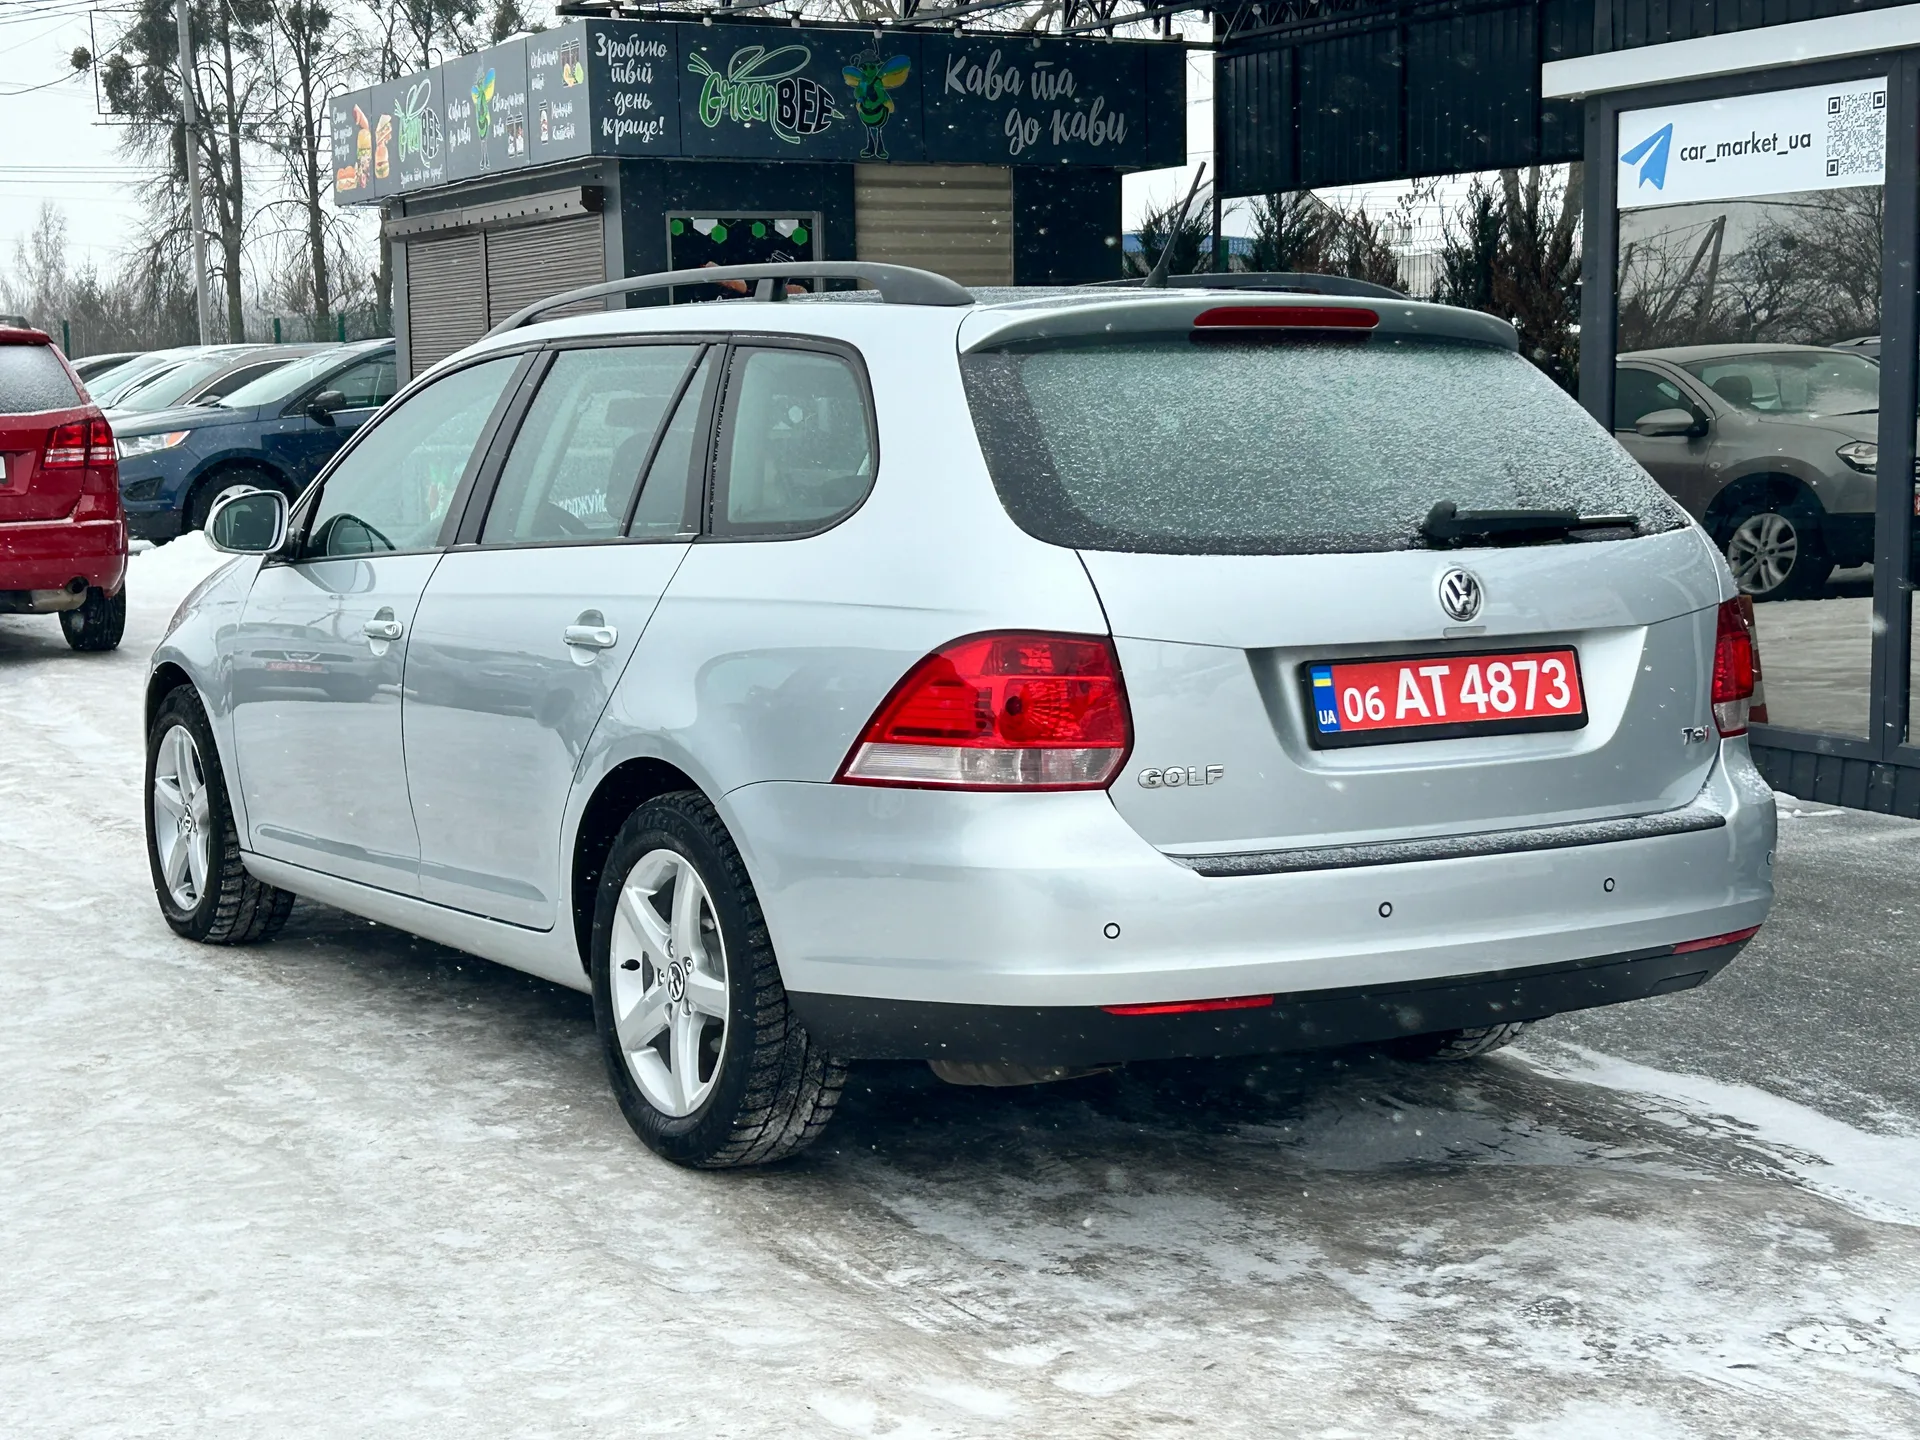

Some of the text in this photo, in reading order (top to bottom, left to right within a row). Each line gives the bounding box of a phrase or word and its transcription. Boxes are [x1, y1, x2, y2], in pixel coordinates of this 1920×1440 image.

[595, 32, 667, 65] Зробимо
[611, 61, 653, 85] твій
[944, 49, 1077, 101] Кава та
[613, 91, 653, 116] день
[602, 116, 664, 145] краще!
[1004, 96, 1128, 156] до кави
[1680, 130, 1812, 163] car_market_ua
[1342, 658, 1571, 723] 06 AT 4873
[1318, 709, 1337, 725] UA
[1137, 763, 1224, 789] GOLF
